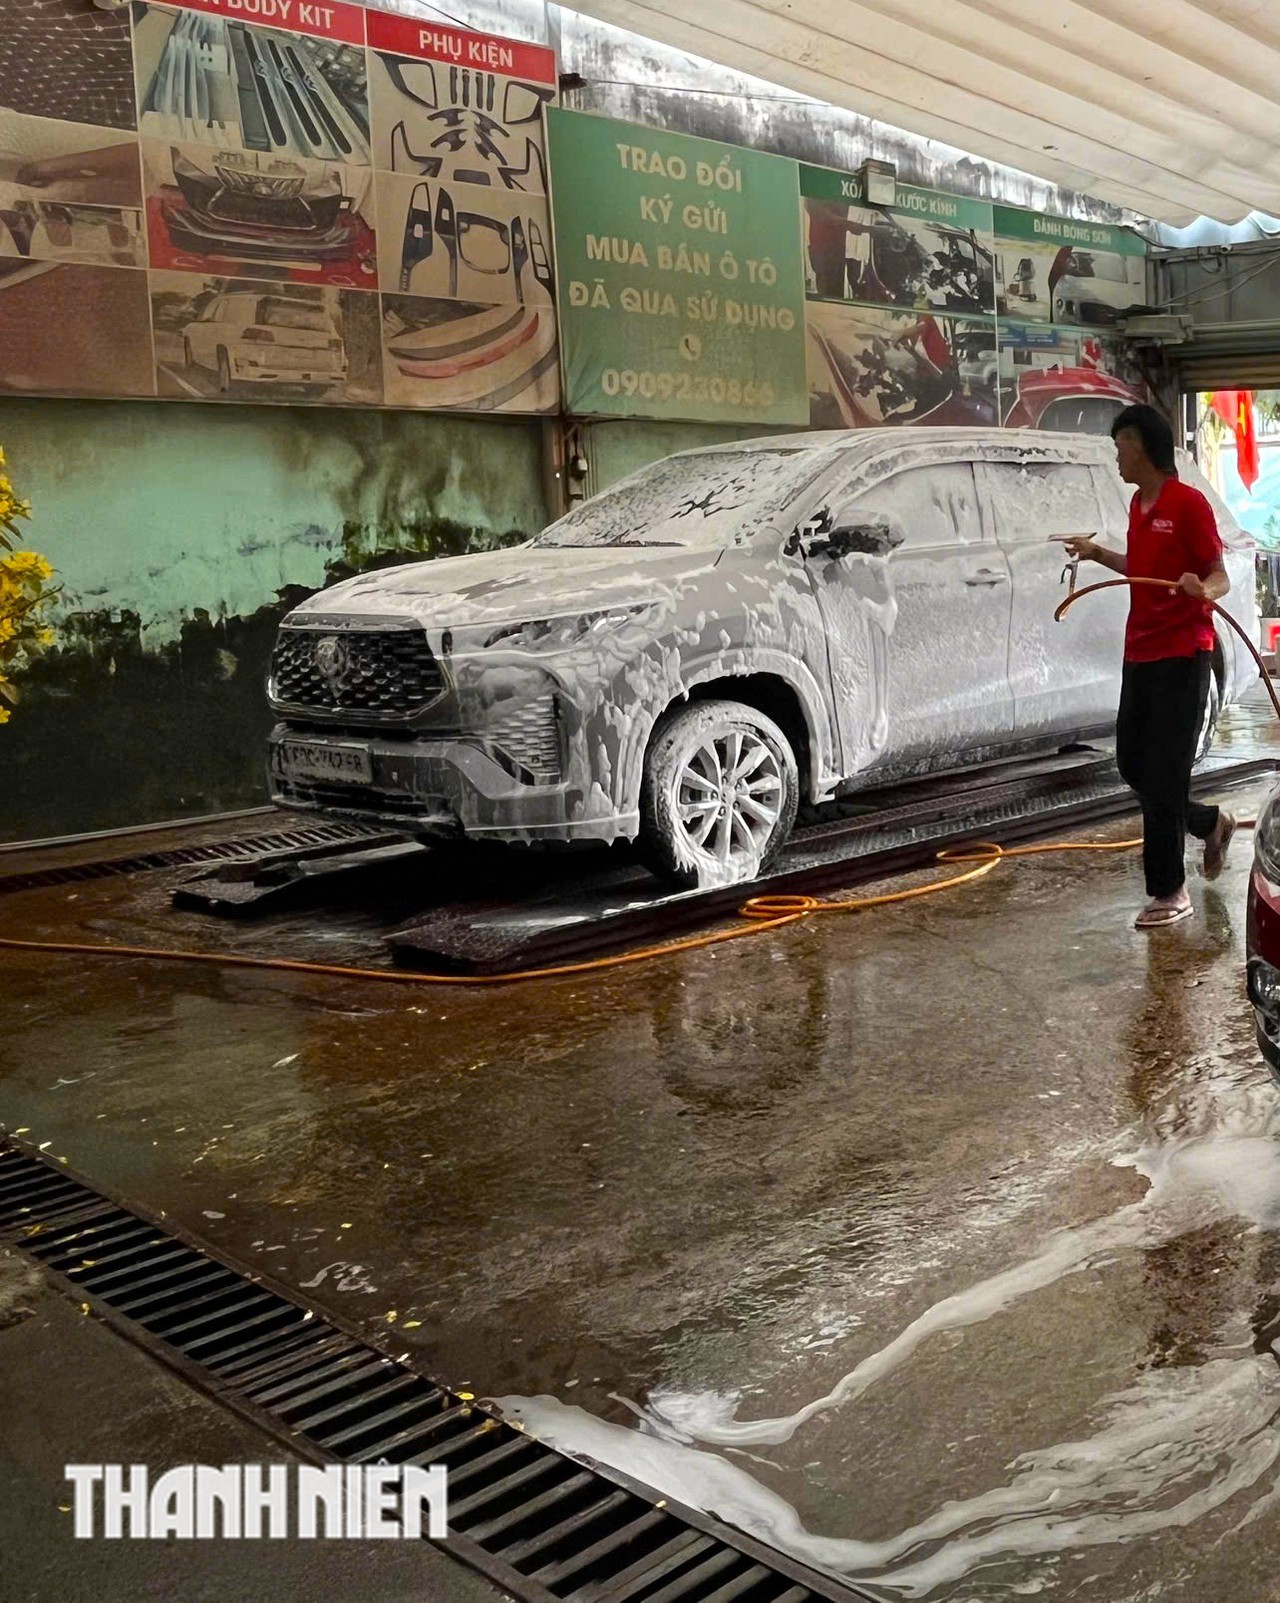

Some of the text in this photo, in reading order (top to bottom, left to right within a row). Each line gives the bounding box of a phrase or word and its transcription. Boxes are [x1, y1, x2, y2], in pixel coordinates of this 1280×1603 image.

[299, 3, 335, 29] KIT
[419, 29, 514, 68] PHỤ KIỆN
[616, 143, 742, 193] TRAO ĐỔI
[840, 178, 862, 200] XÓ
[639, 193, 728, 234] KÝ GỬI
[586, 234, 778, 287] MUA BÁN Ô TÔ
[619, 287, 680, 319] QUA
[686, 290, 719, 322] SỬ
